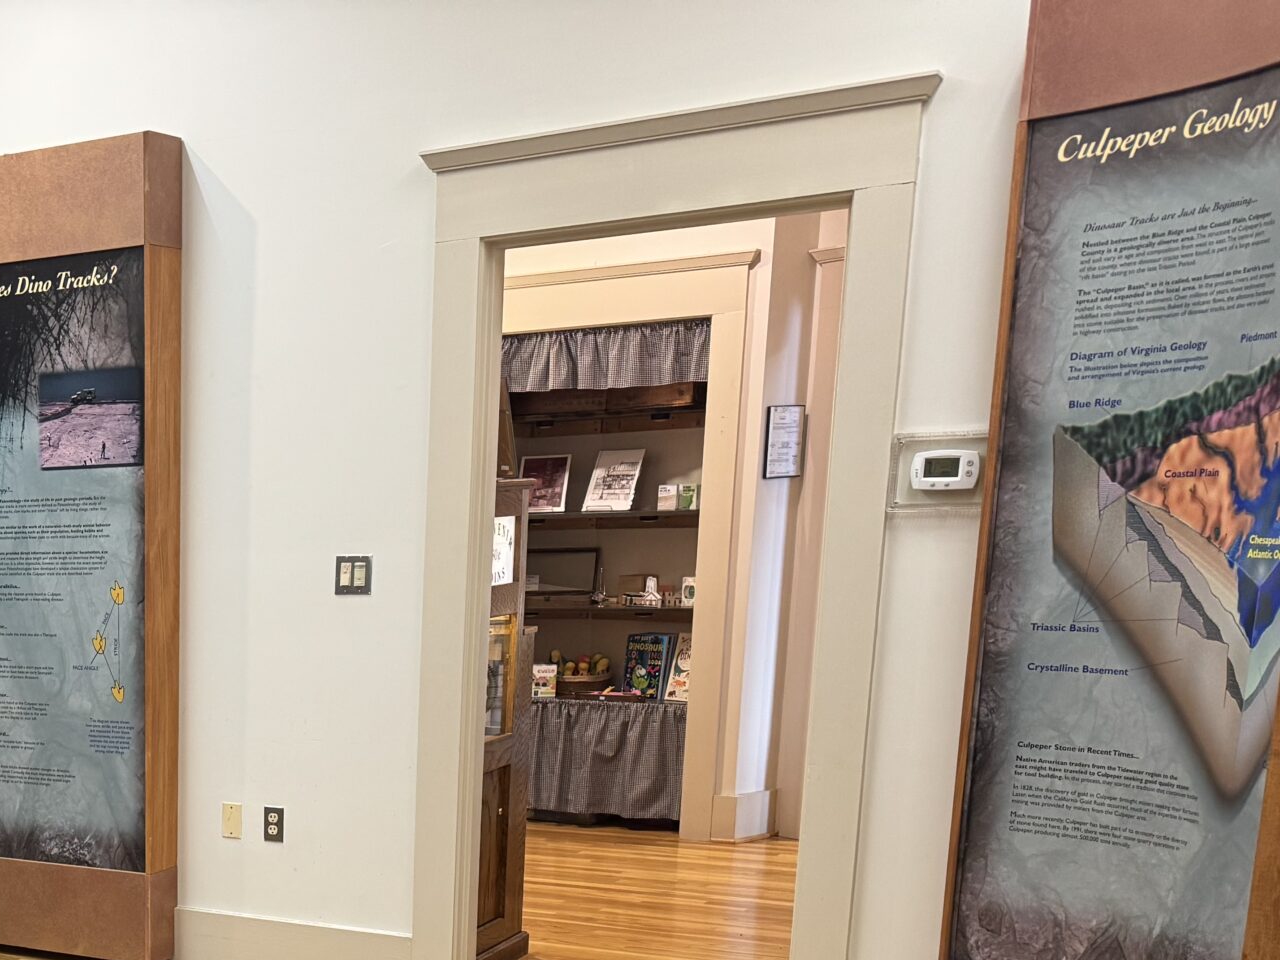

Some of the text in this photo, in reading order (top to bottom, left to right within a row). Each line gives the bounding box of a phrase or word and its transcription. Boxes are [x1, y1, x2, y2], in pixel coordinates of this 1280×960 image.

[1057, 97, 1278, 163] Culpeper Geology
[1083, 221, 1127, 233] Dinosaur
[1130, 213, 1159, 226] Tracks
[1161, 213, 1176, 221] are
[1177, 208, 1196, 218] Just
[1198, 204, 1211, 214] the
[1110, 236, 1138, 245] between
[1209, 221, 1231, 229] Coastal
[1248, 211, 1272, 221] Culpeper
[1081, 249, 1105, 257] County
[1119, 242, 1156, 253] geologically
[1157, 238, 1179, 246] diverse
[1261, 262, 1274, 270] crust
[15, 275, 51, 296] Dino
[56, 265, 118, 291] Tracks?
[1076, 297, 1098, 305] spread
[1114, 292, 1144, 300] expanded
[1240, 331, 1278, 343] Piedmont
[1070, 340, 1208, 362] Diagram of Virginia Geology
[1069, 365, 1081, 373] The
[1083, 363, 1118, 372] illustration
[1119, 361, 1138, 369] below
[1140, 360, 1161, 368] depicts
[1173, 355, 1209, 364] composition
[1081, 371, 1122, 380] arrangement
[1068, 398, 1122, 409] Blue Ridge
[1164, 468, 1220, 478] Coastal Plain
[1246, 548, 1272, 559] Atlantic
[1031, 623, 1100, 633] Triassic Basins
[628, 642, 663, 651] DINOSAUR
[1027, 662, 1129, 676] Crystalline Basement
[1017, 741, 1052, 750] Culpeper
[1054, 743, 1076, 753] Stone
[1087, 747, 1112, 756] Recent
[1016, 755, 1037, 763] Native
[1038, 758, 1068, 766] American
[1069, 761, 1090, 769] traders
[1092, 763, 1106, 771] from
[1117, 766, 1144, 775] Tidewater
[1145, 771, 1162, 779] region
[1029, 764, 1047, 773] might
[1064, 767, 1088, 776] traveled
[1096, 771, 1122, 780] Culpeper
[1123, 776, 1143, 784] seeking
[1158, 781, 1175, 789] quality
[1045, 787, 1069, 796] discovery
